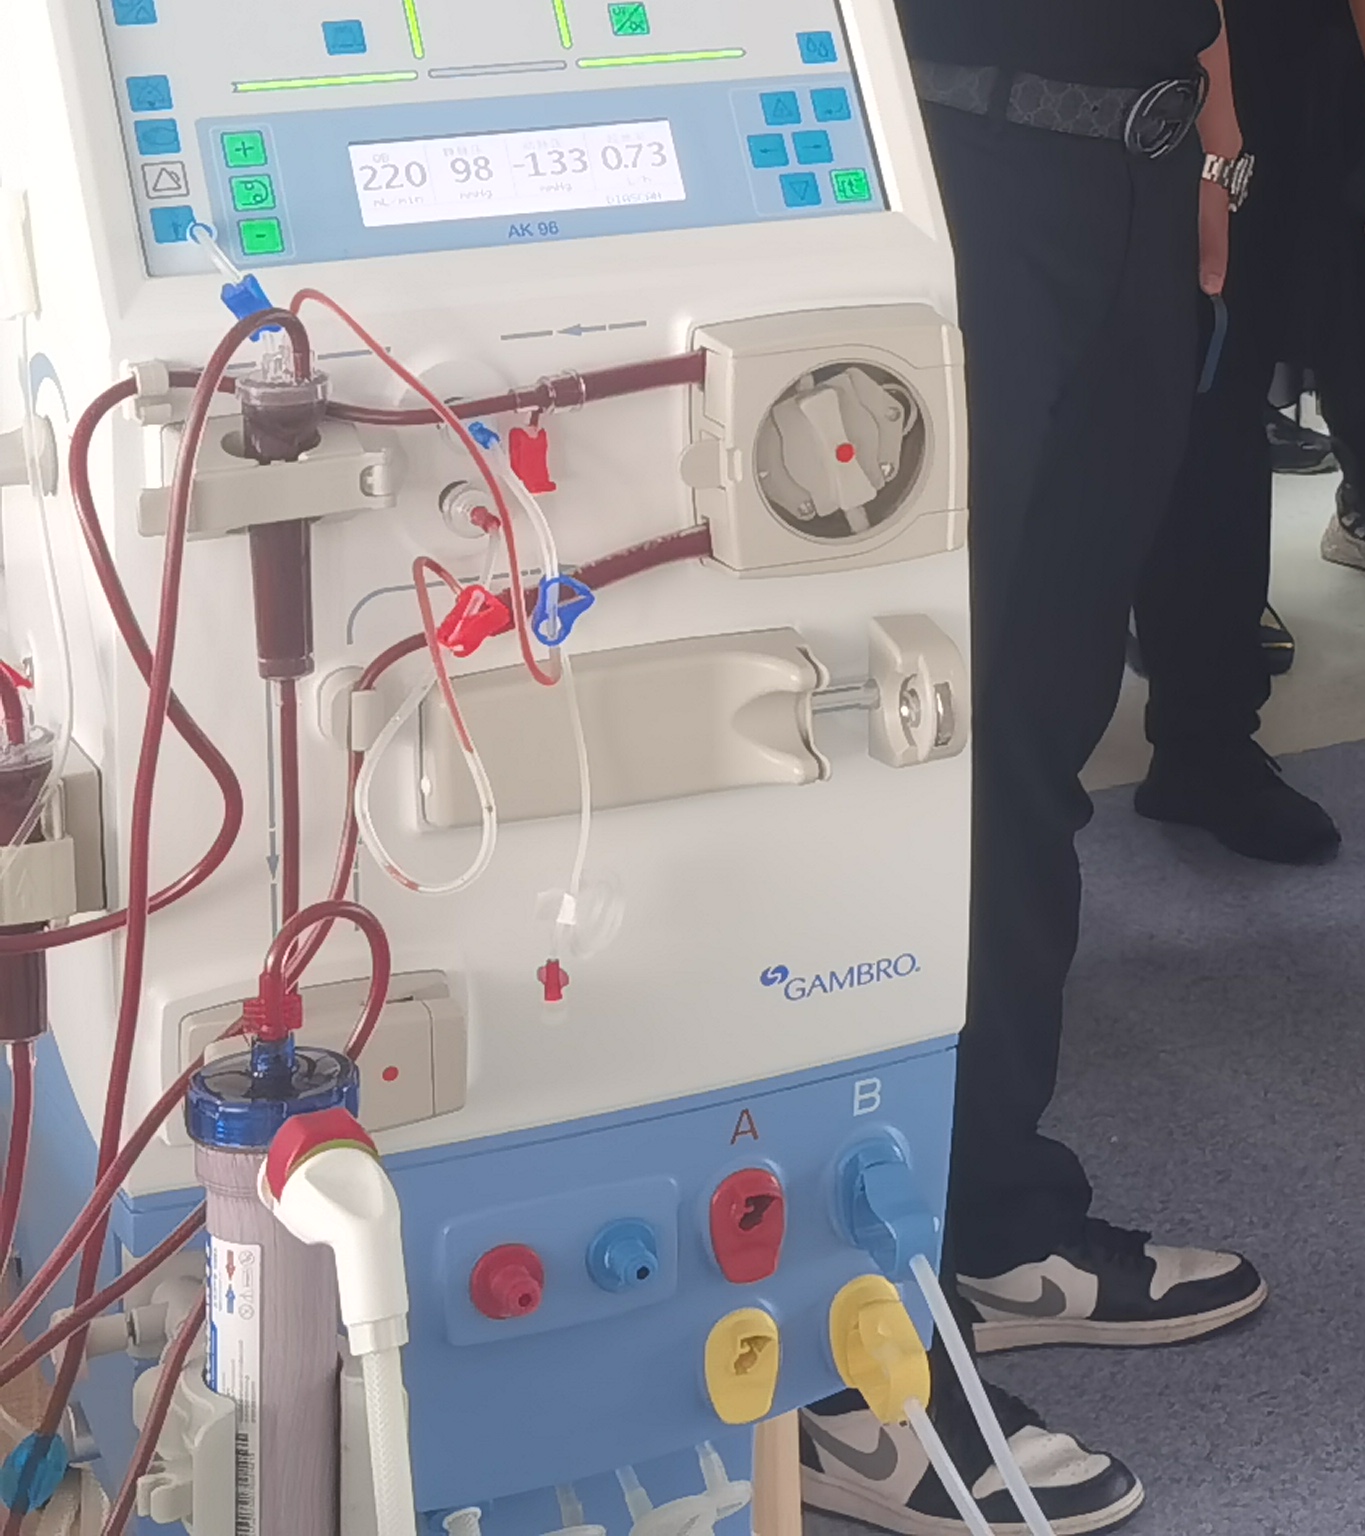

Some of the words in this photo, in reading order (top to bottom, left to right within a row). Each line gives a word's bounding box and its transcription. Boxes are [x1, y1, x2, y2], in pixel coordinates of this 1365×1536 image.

[359, 161, 427, 191] 220
[450, 156, 493, 183] 98
[513, 148, 588, 177] -133
[601, 141, 667, 171] 0.73
[508, 224, 533, 238] AK
[784, 953, 917, 1001] GAMBRO
[853, 1077, 881, 1116] B
[731, 1108, 759, 1145] A
